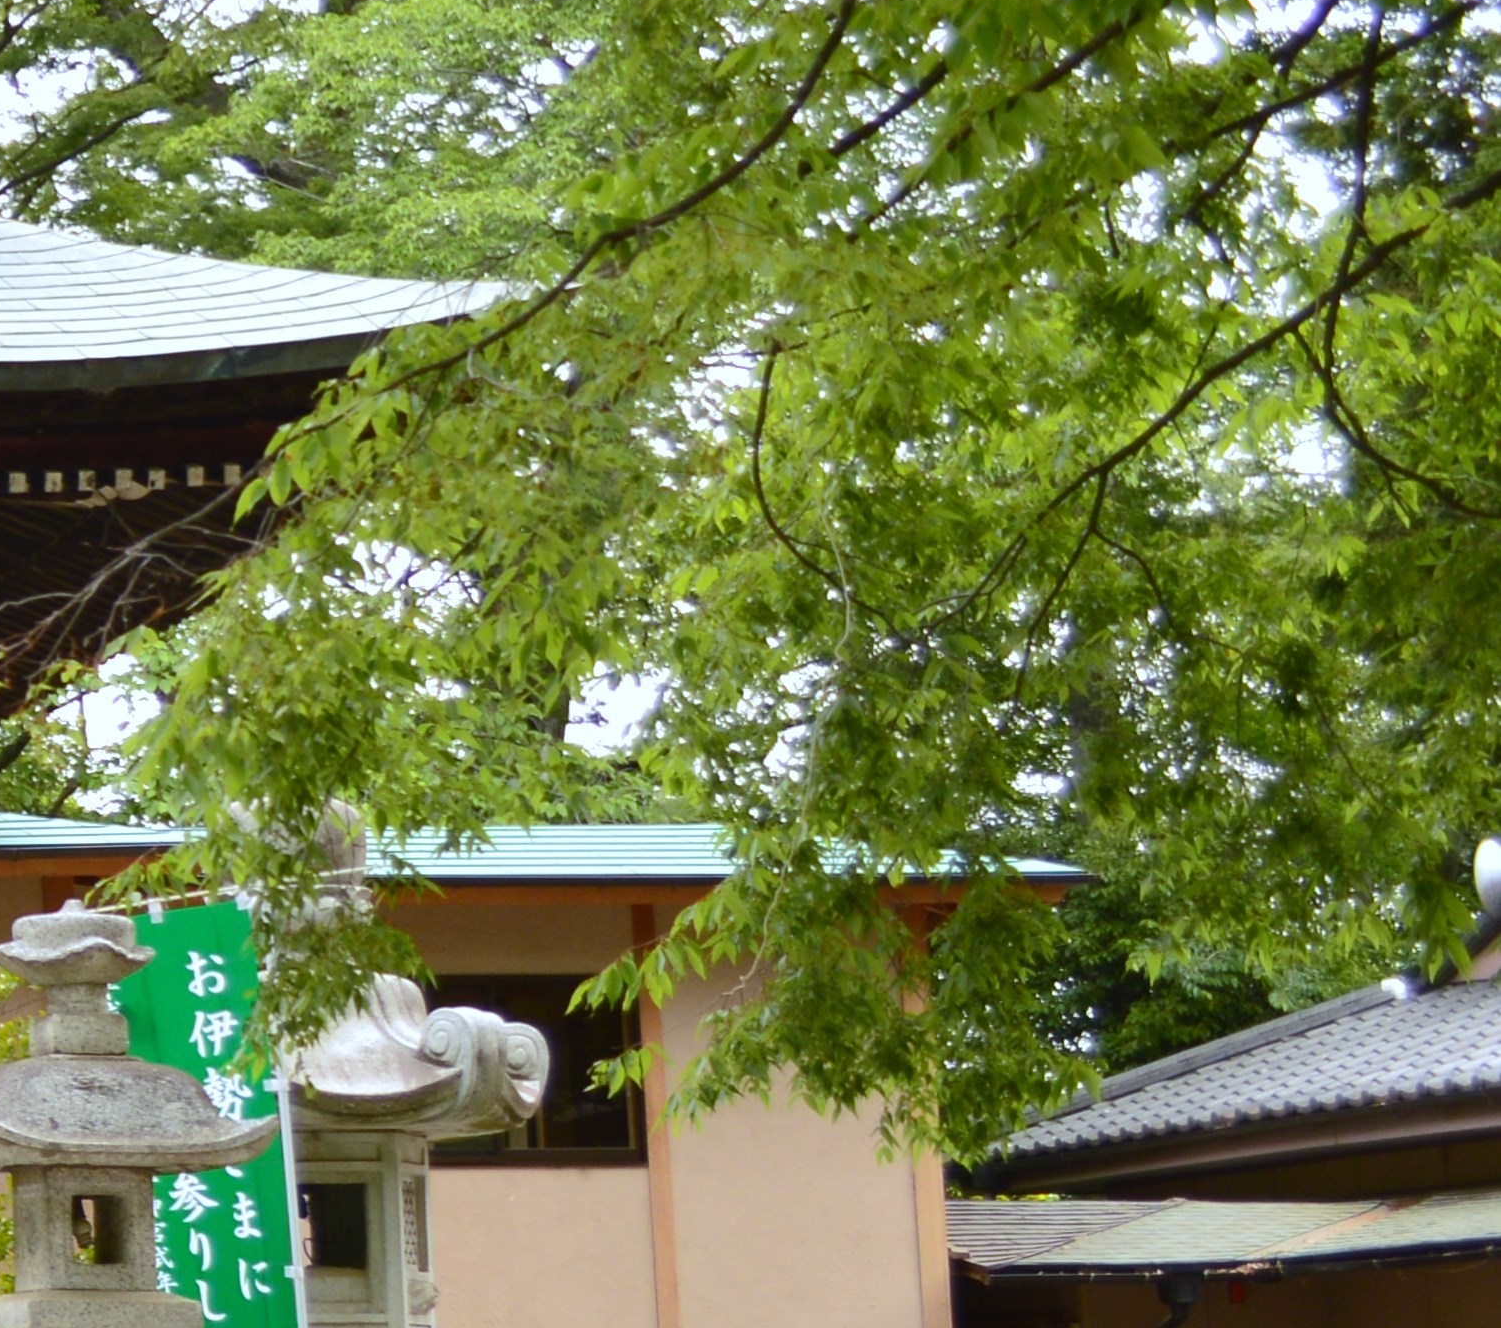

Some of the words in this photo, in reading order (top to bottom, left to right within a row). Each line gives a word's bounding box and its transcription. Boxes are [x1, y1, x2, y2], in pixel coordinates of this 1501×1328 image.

[186, 950, 273, 1301] お伊勢まに
